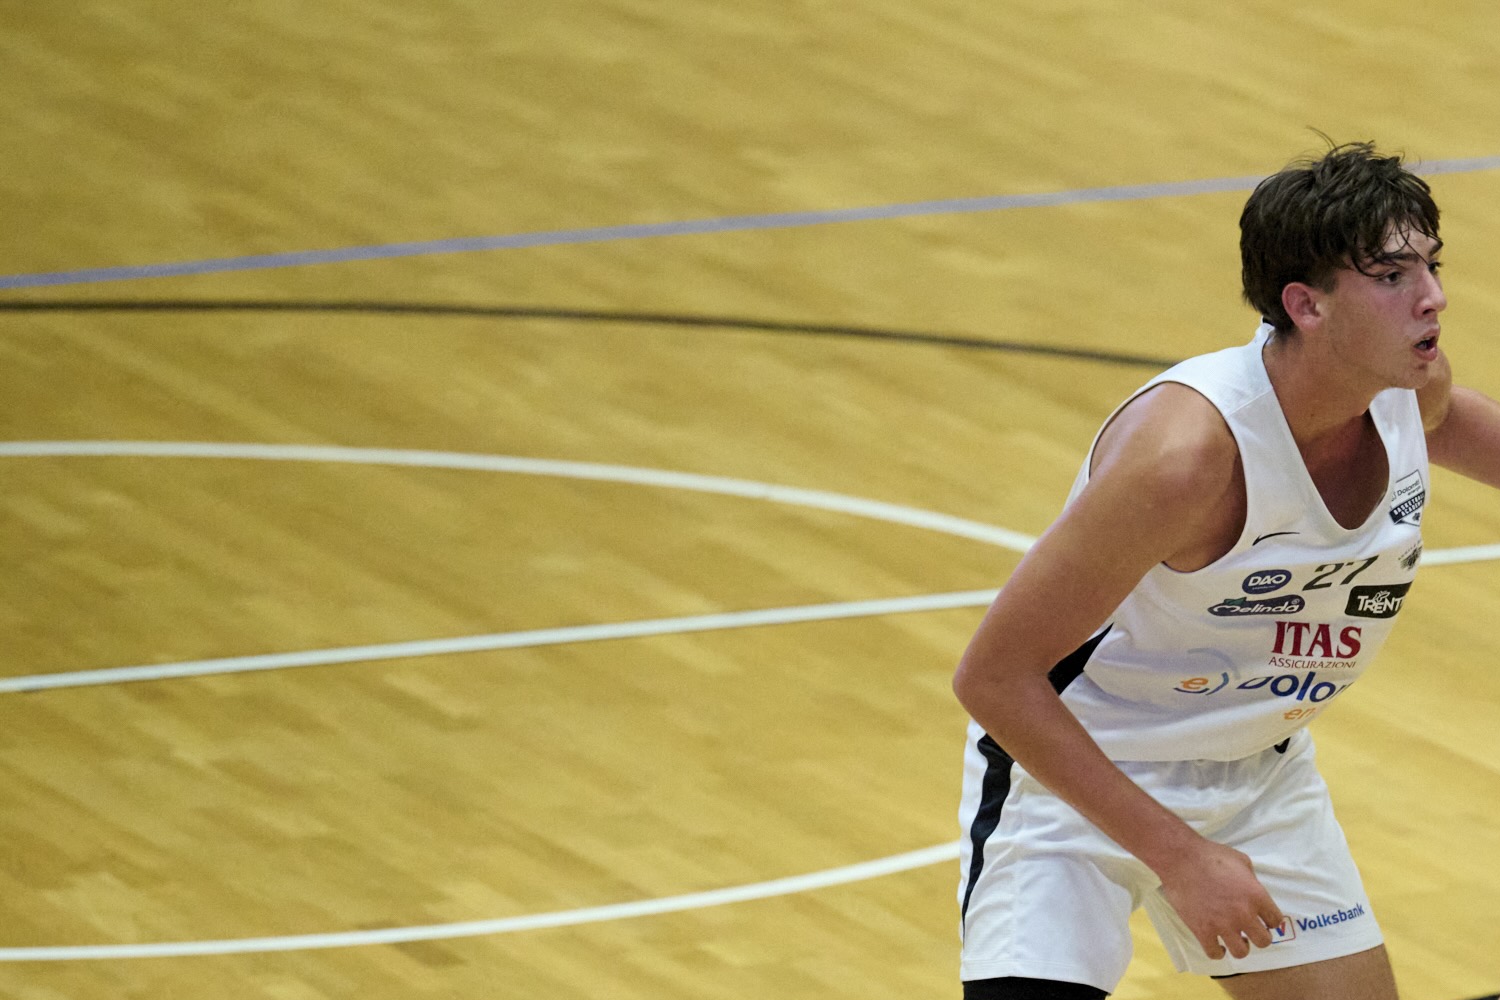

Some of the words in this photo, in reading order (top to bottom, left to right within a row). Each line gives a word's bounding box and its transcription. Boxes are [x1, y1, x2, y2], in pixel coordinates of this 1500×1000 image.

[1248, 574, 1287, 587] DAO
[1301, 555, 1379, 592] 27
[1213, 601, 1300, 613] Melinda
[1270, 620, 1362, 659] ITAS
[1269, 656, 1357, 670] ASSICURAZIONI
[1296, 903, 1365, 932] Volksbank
